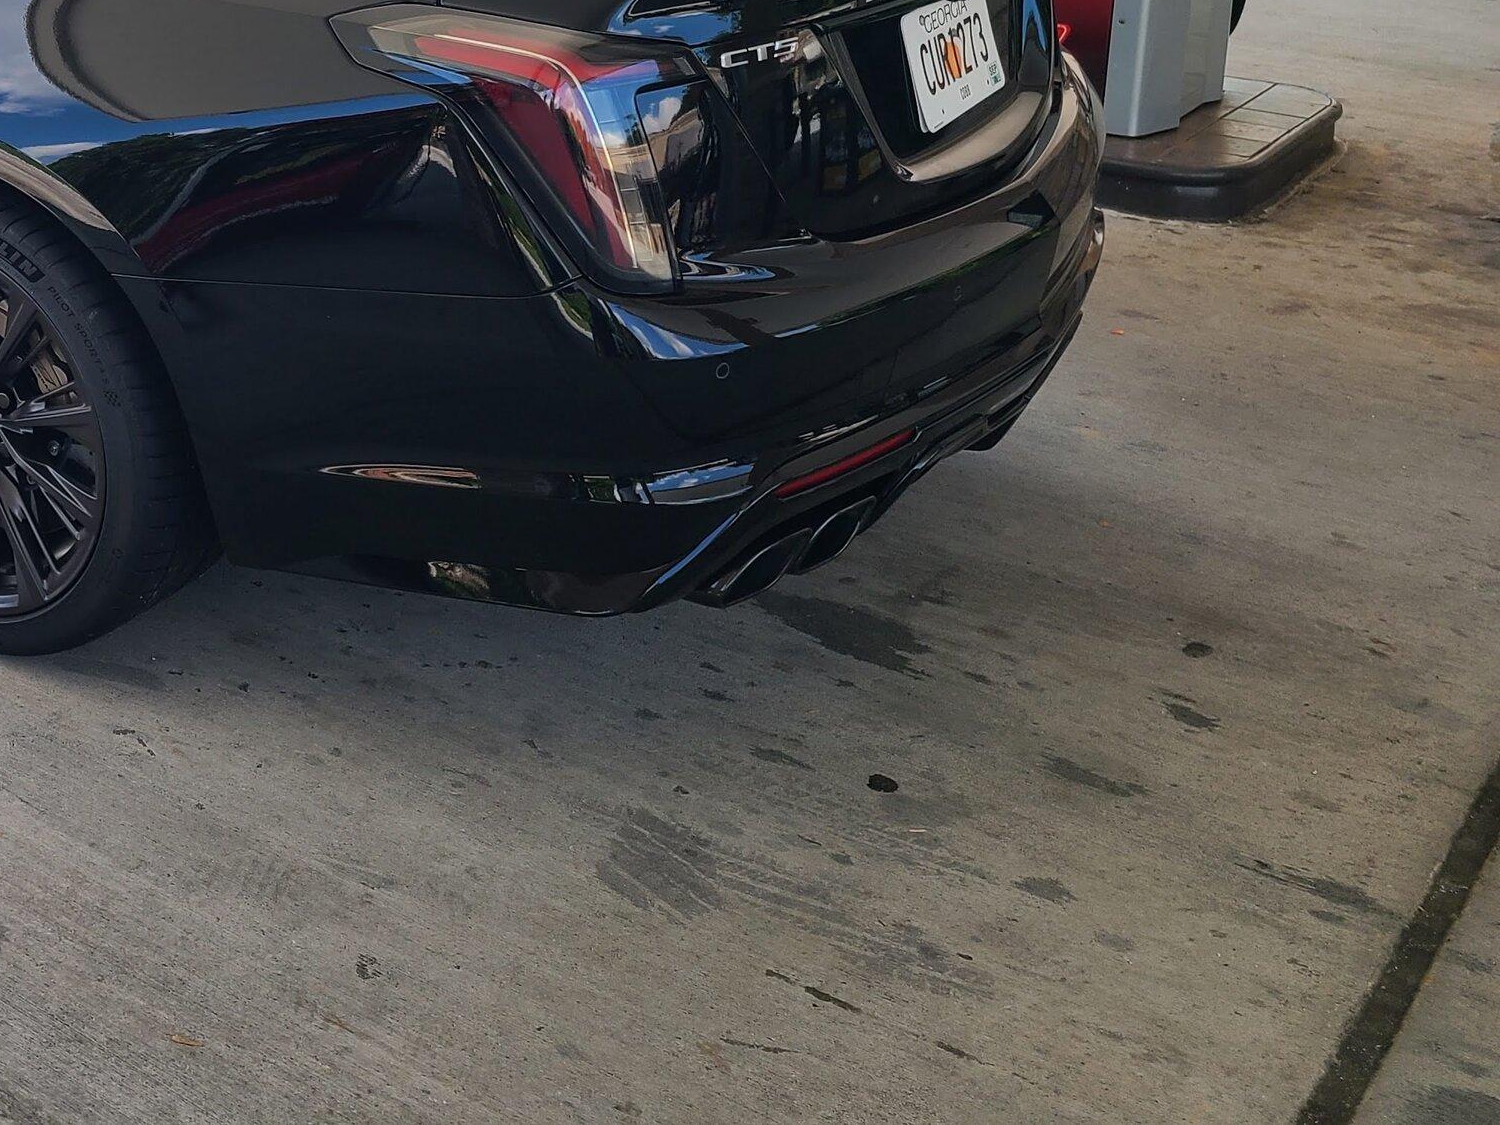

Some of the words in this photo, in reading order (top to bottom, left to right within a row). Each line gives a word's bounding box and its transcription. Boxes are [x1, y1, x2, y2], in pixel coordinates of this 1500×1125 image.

[923, 0, 968, 34] GEORGIA
[720, 37, 799, 69] CT5
[47, 285, 76, 319] PILOT
